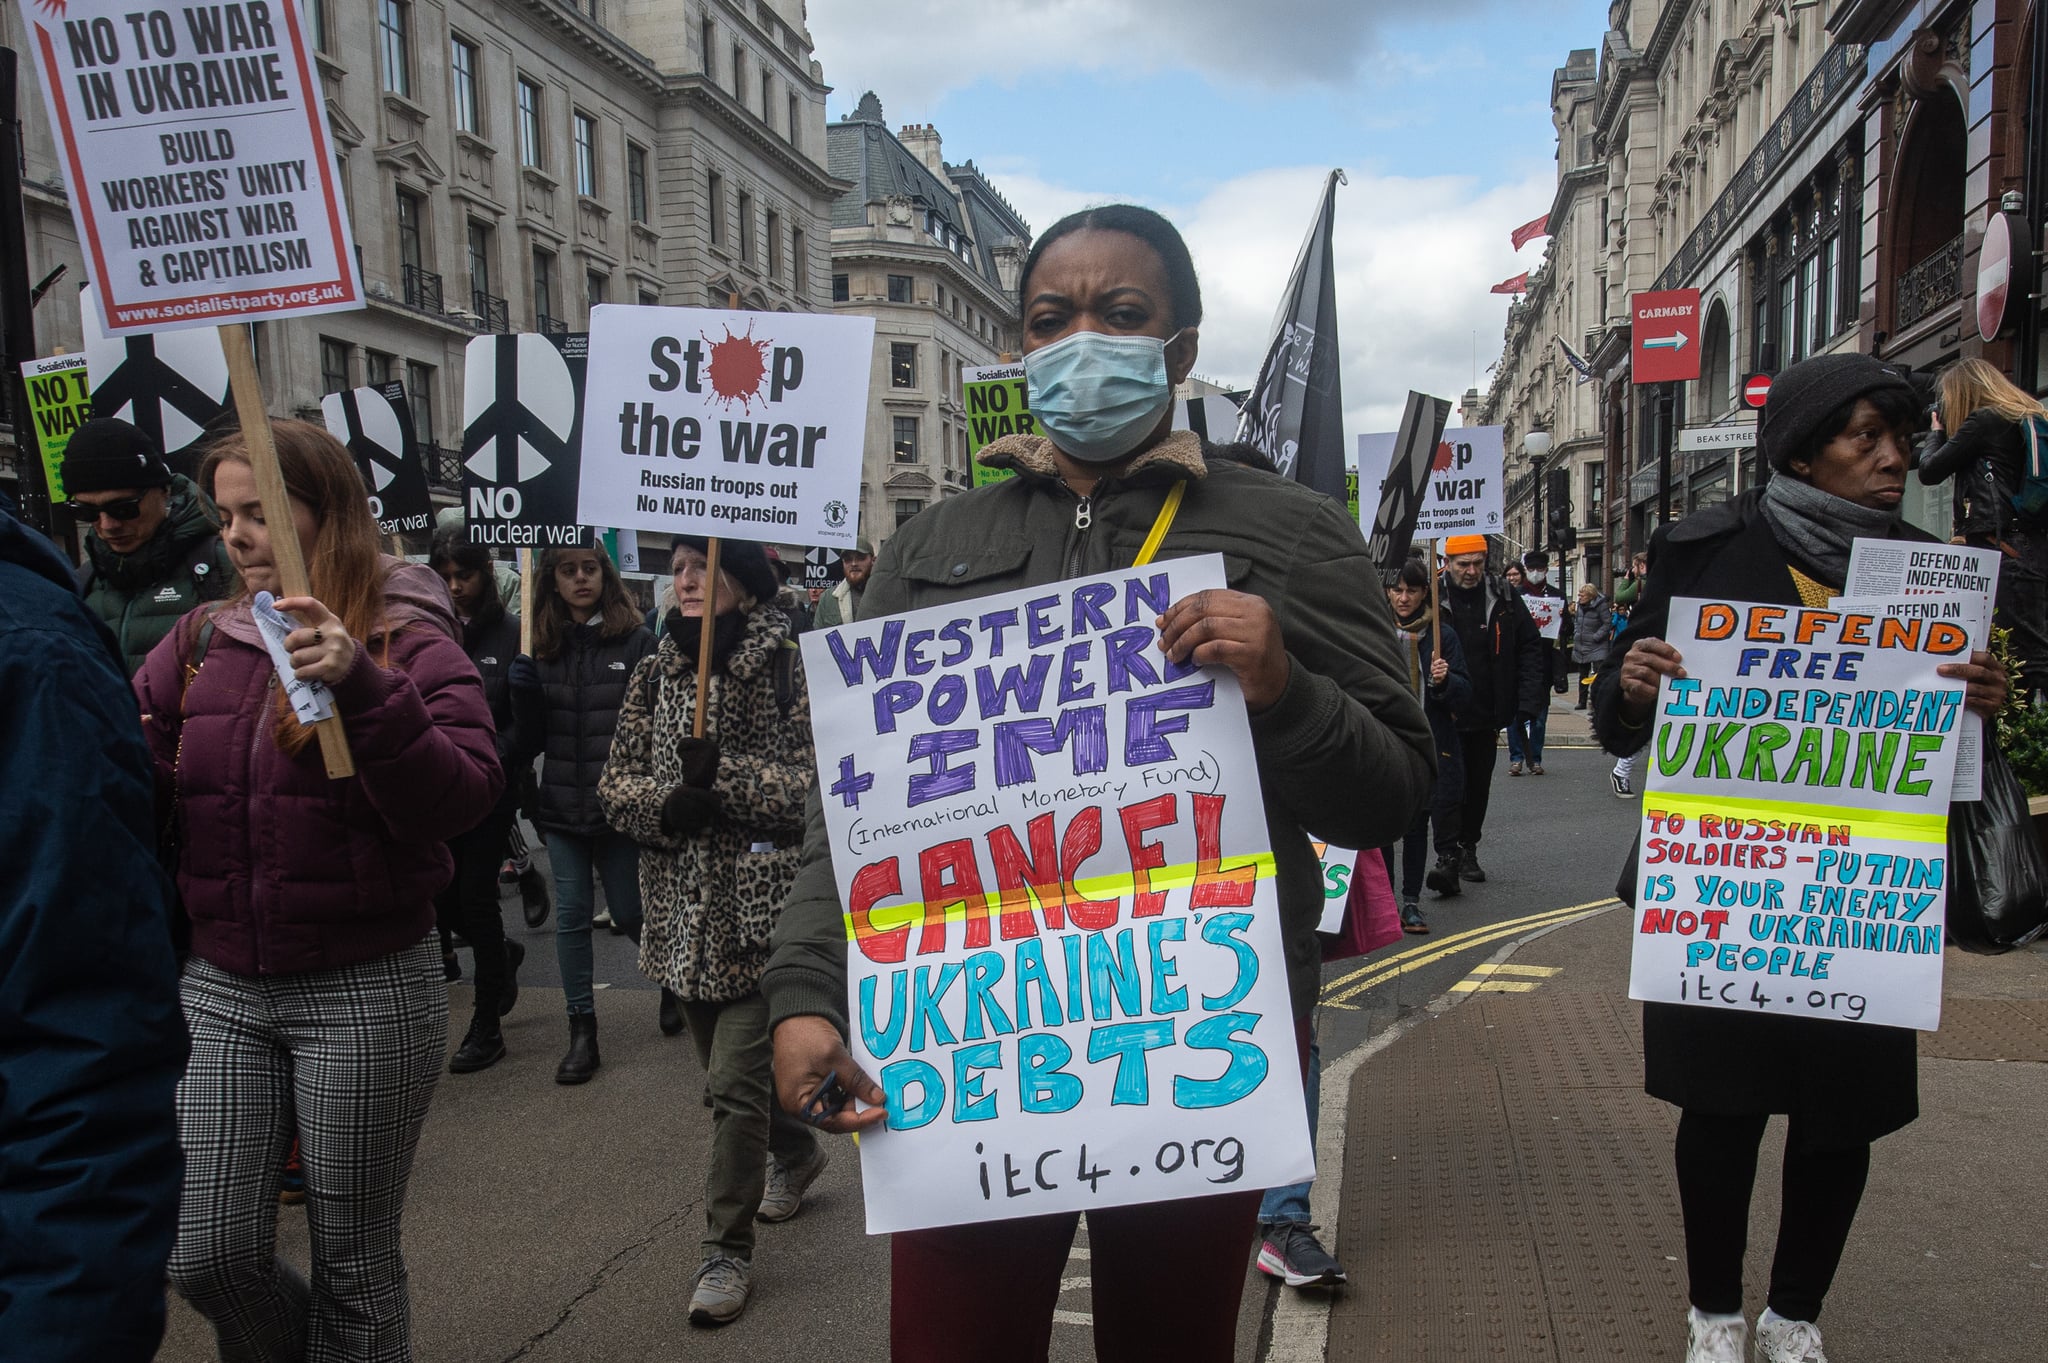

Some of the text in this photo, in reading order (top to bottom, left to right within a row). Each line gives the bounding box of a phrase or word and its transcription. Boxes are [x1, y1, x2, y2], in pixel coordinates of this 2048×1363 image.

[64, 0, 277, 68] NO TO WAR
[77, 53, 289, 121] IN UKRAINE
[160, 128, 235, 166] BUILD
[102, 160, 308, 213] WORKERS' UNITY
[127, 201, 298, 249] AGAINST WAR
[139, 239, 312, 287] & CAPITALISM
[117, 284, 344, 323] www.socialistparty.org.uk
[1638, 305, 1693, 319] CARNABY
[37, 357, 87, 374] Socialist Work
[977, 367, 1025, 381] Socialist Wor
[31, 371, 89, 407] NO T
[970, 382, 1030, 414] NO T
[36, 404, 92, 438] WAR
[619, 402, 827, 468] the war
[971, 414, 1035, 445] WAR
[1696, 435, 1721, 443] BEAK
[640, 469, 799, 499] Russian troops out
[1434, 477, 1485, 501] war
[469, 487, 522, 520] NO
[636, 495, 798, 526] No NATO expansion
[1433, 508, 1459, 517] troops
[1461, 506, 1474, 515] out
[402, 513, 428, 531] war
[470, 520, 585, 545] nuclear war
[1416, 518, 1476, 530] ATO expansion
[806, 565, 828, 578] NO
[1910, 552, 1979, 573] DEFEND AN
[805, 579, 836, 588] nuclear
[1906, 570, 1991, 593] INDEPENDENT
[1942, 603, 1961, 618] AN
[825, 572, 1171, 688] WESTERN
[1695, 603, 1968, 656] DEFEND
[1736, 648, 1865, 681] FREE
[1664, 678, 1964, 733] INDEPENDENT
[906, 679, 1215, 808] IMF
[1656, 722, 1946, 797] UKRAINE
[848, 749, 1221, 855] (International Monetary Fund)
[1647, 808, 1851, 847] TO RUSSIAN
[1646, 838, 1787, 870] SOLDIERS
[849, 793, 1257, 963] CANCEL
[1644, 874, 1937, 923] IS YOUR ENEMY
[1640, 907, 1942, 955] NOT UKRAINIAN
[1686, 941, 1834, 980] PEOPLE
[858, 912, 1260, 1060] UKRAINE'S
[881, 1011, 1269, 1132] DEBTS
